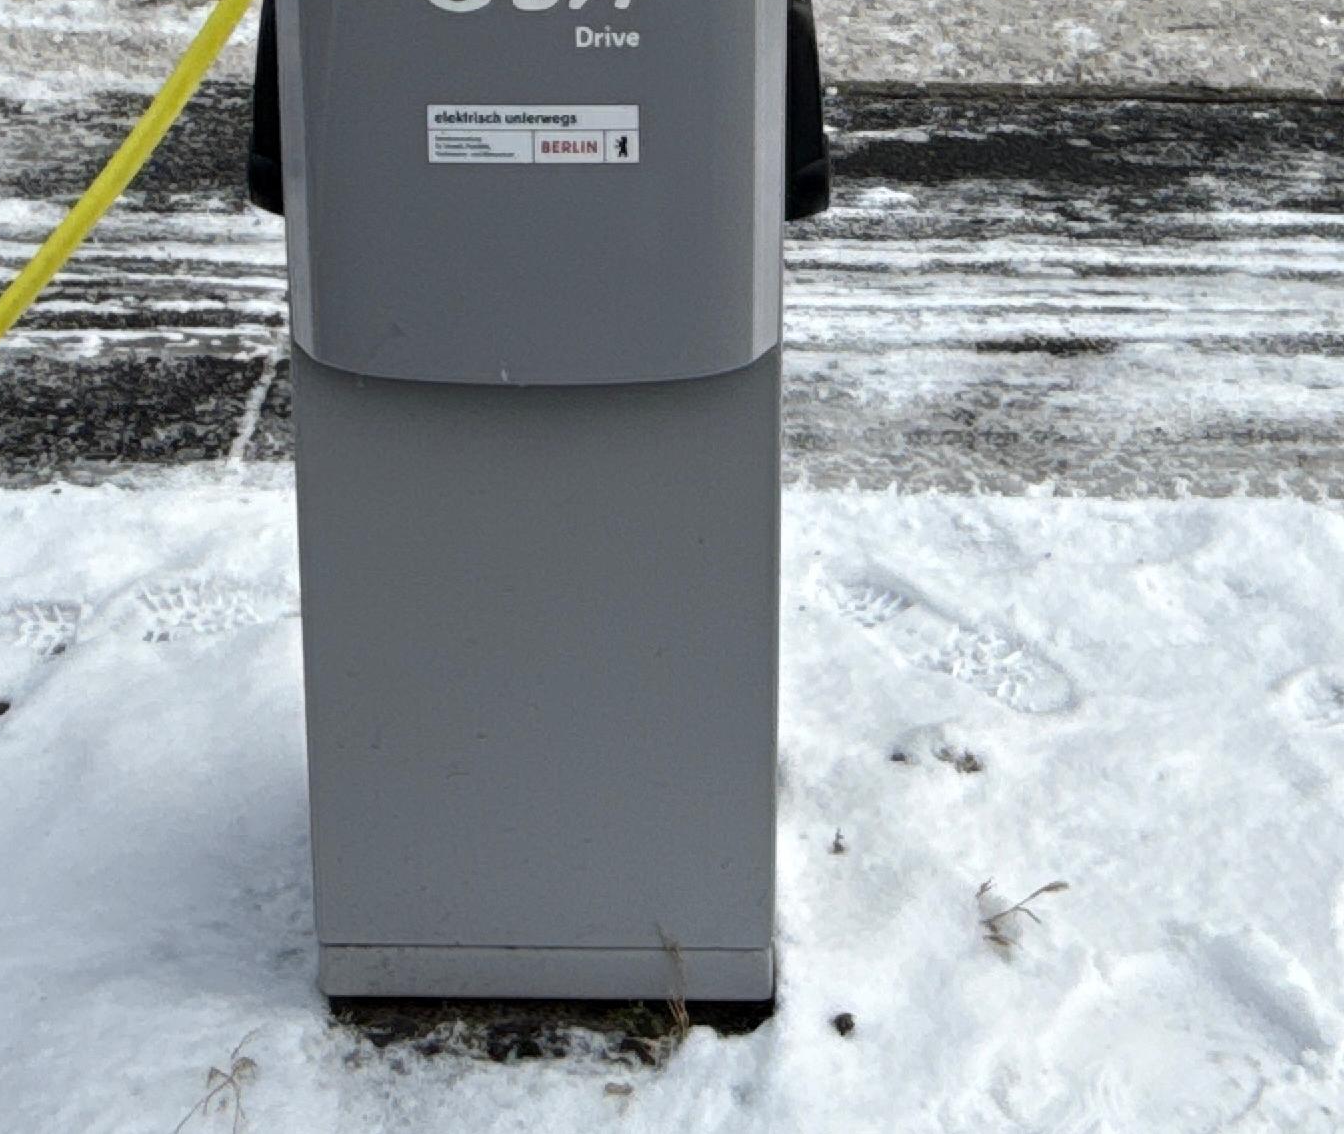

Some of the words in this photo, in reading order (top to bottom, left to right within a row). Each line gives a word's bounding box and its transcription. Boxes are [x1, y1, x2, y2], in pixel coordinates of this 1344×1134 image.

[575, 26, 640, 48] Drive
[434, 110, 502, 124] elektrisch
[504, 112, 578, 127] unterwegs
[540, 140, 598, 154] BERLIN
